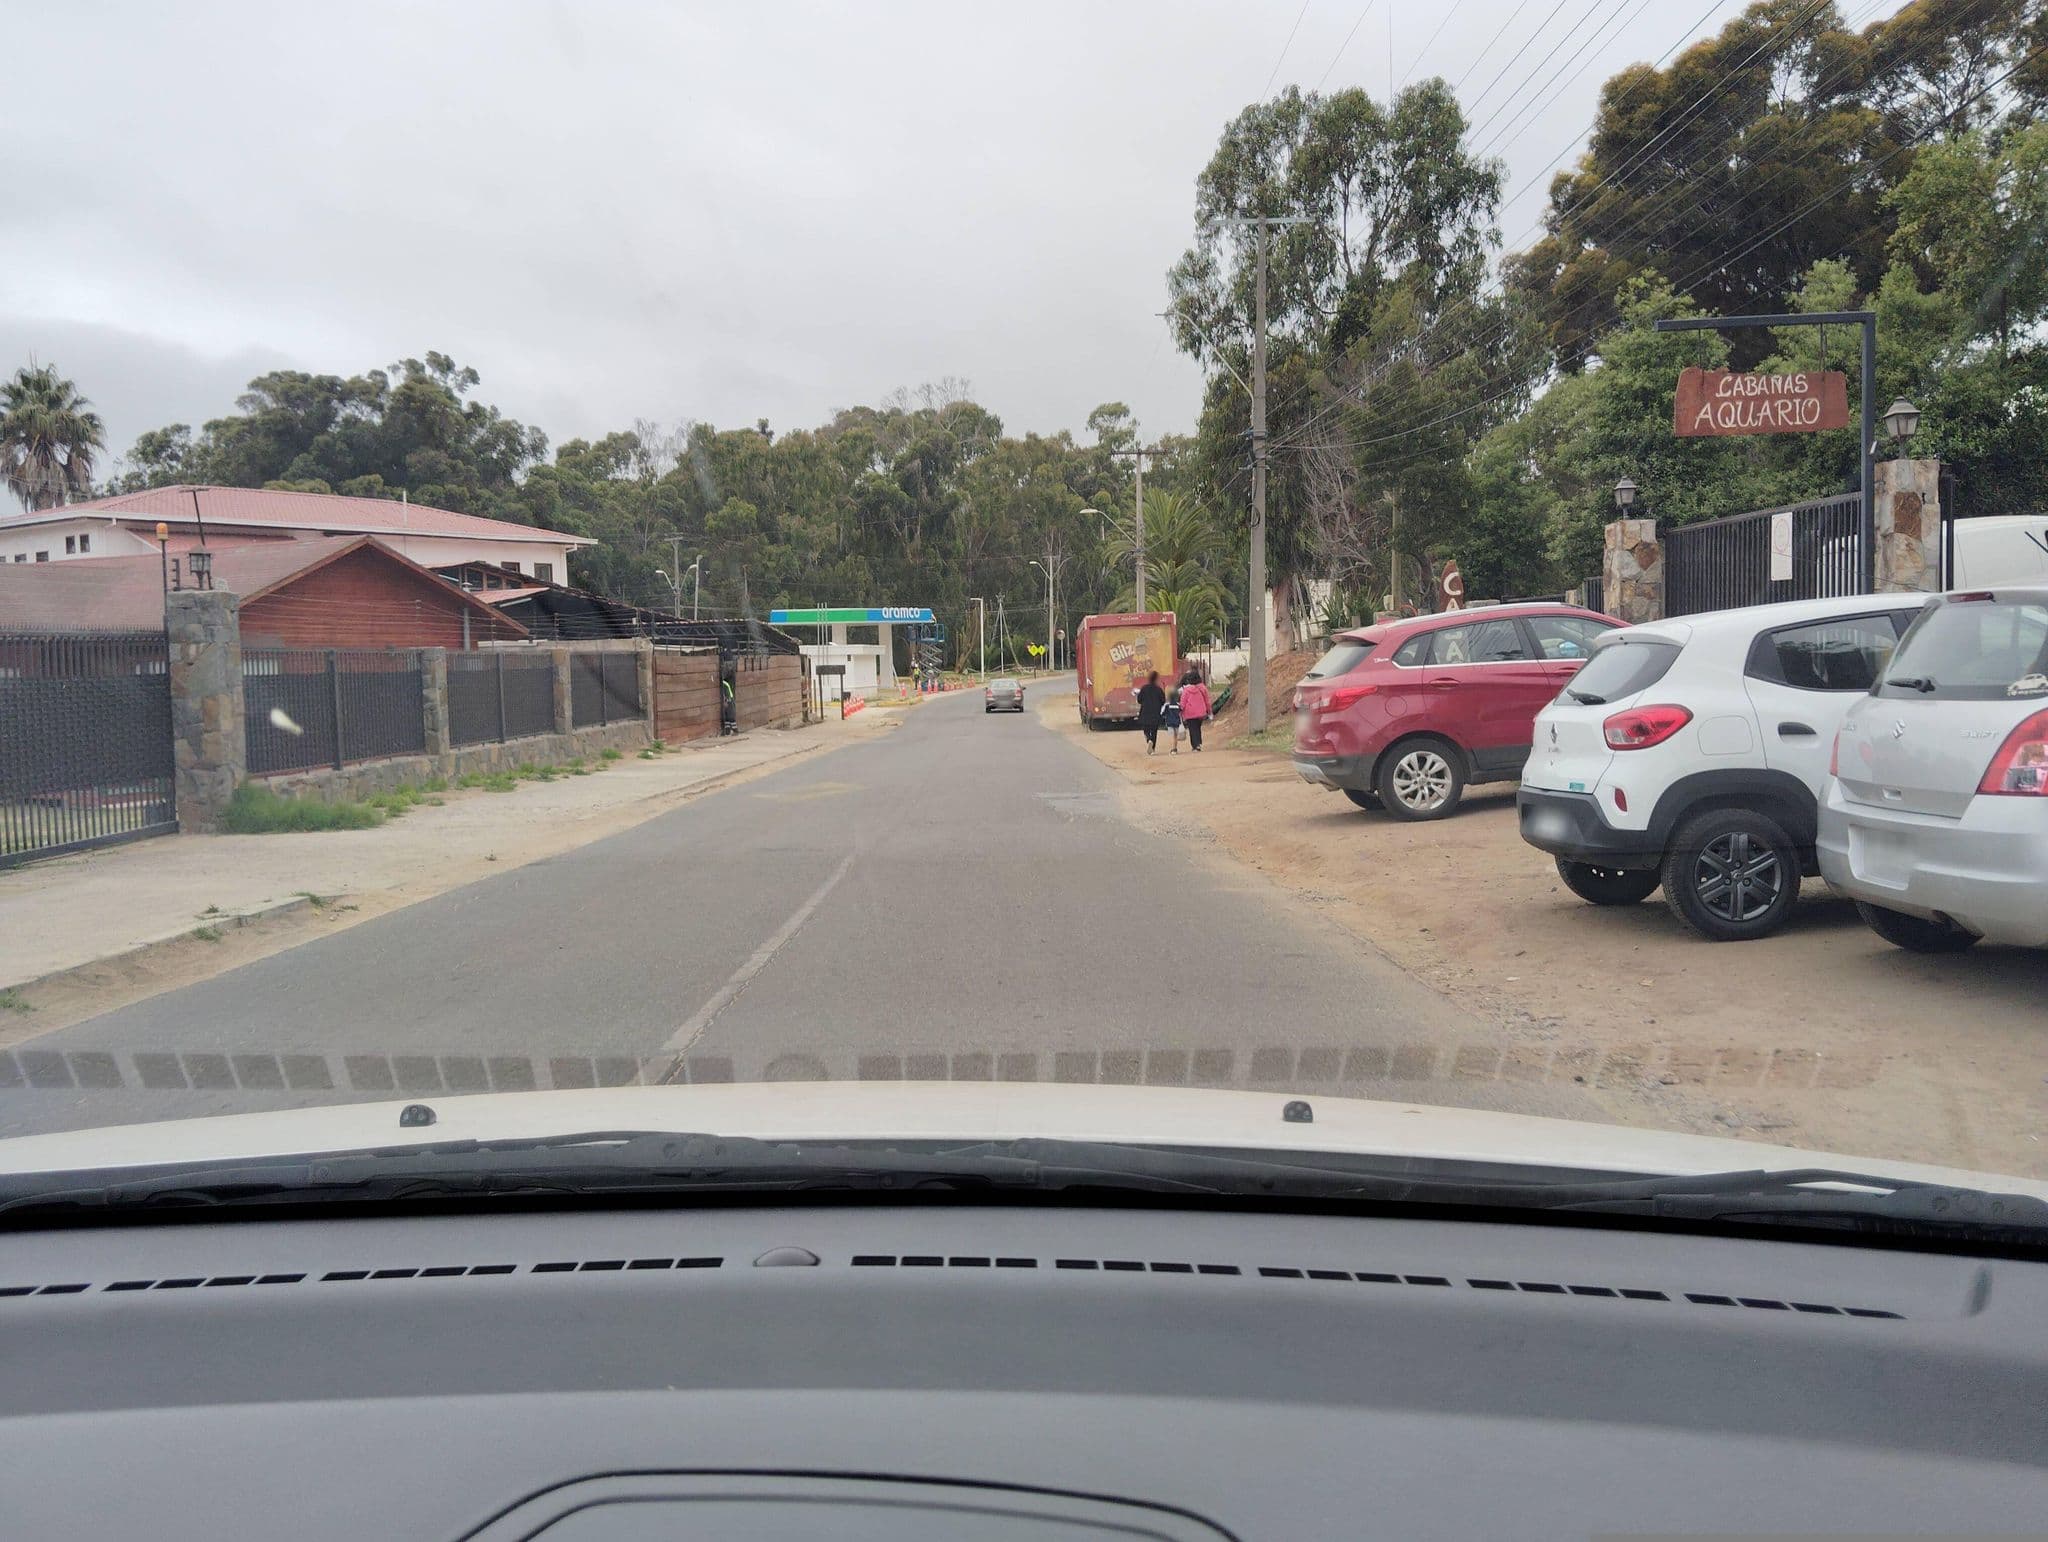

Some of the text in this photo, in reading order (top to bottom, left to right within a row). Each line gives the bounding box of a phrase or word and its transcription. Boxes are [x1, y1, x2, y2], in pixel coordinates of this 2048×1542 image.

[1694, 397, 1820, 430] AQUARIO
[882, 607, 920, 619] aramco
[1109, 644, 1135, 662] Bilz
